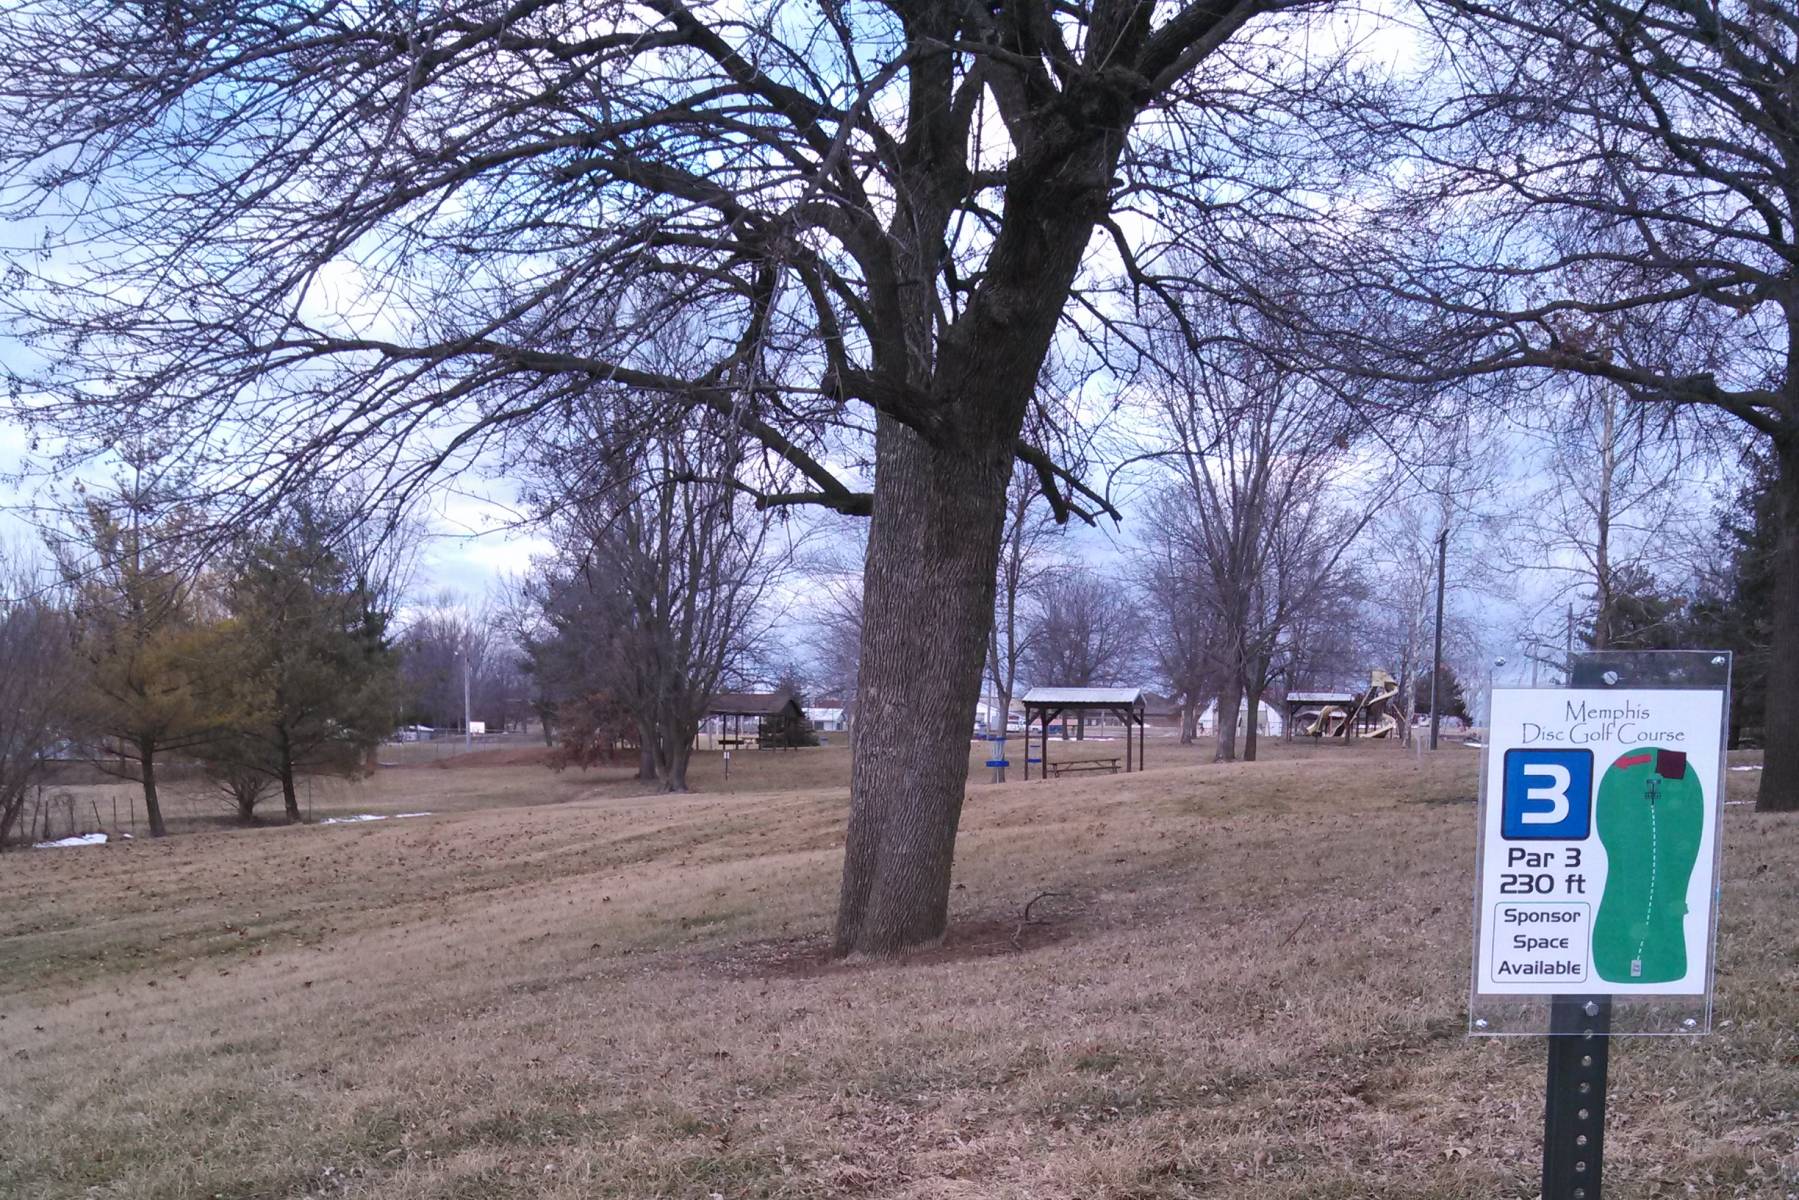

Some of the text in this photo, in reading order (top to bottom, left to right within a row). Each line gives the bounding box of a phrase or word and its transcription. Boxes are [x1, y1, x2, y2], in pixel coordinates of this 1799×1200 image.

[1565, 700, 1650, 727] Memphis
[1522, 721, 1686, 744] Disc Golf Course
[1521, 763, 1572, 825] 3
[1507, 847, 1582, 868] Par 3
[1500, 874, 1586, 894] 230 ft
[1504, 909, 1581, 925] Sponsor
[1513, 934, 1569, 951] Space
[1498, 961, 1581, 976] Available
